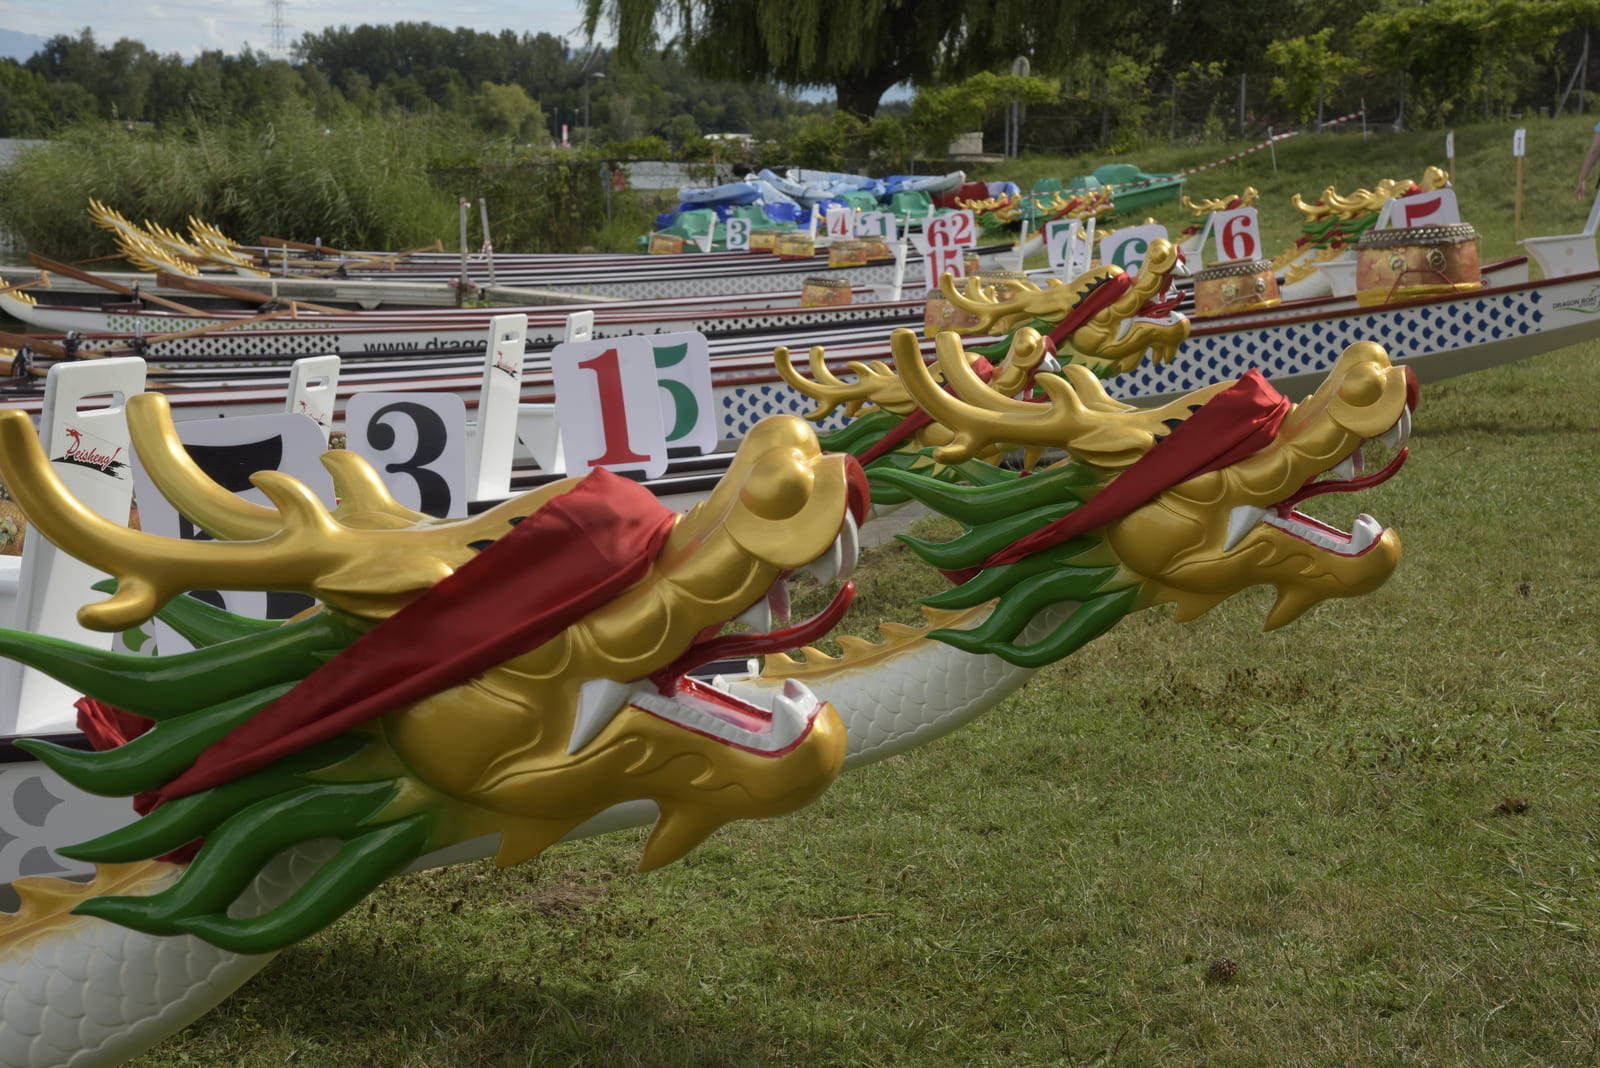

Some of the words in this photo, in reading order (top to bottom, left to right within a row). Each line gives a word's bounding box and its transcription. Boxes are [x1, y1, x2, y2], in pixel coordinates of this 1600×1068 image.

[729, 219, 748, 246] 3
[831, 212, 849, 235] 4
[1222, 215, 1255, 260] 6
[1111, 237, 1148, 276] 6
[577, 347, 652, 467] 1
[652, 341, 700, 443] 5
[366, 401, 452, 519] 3
